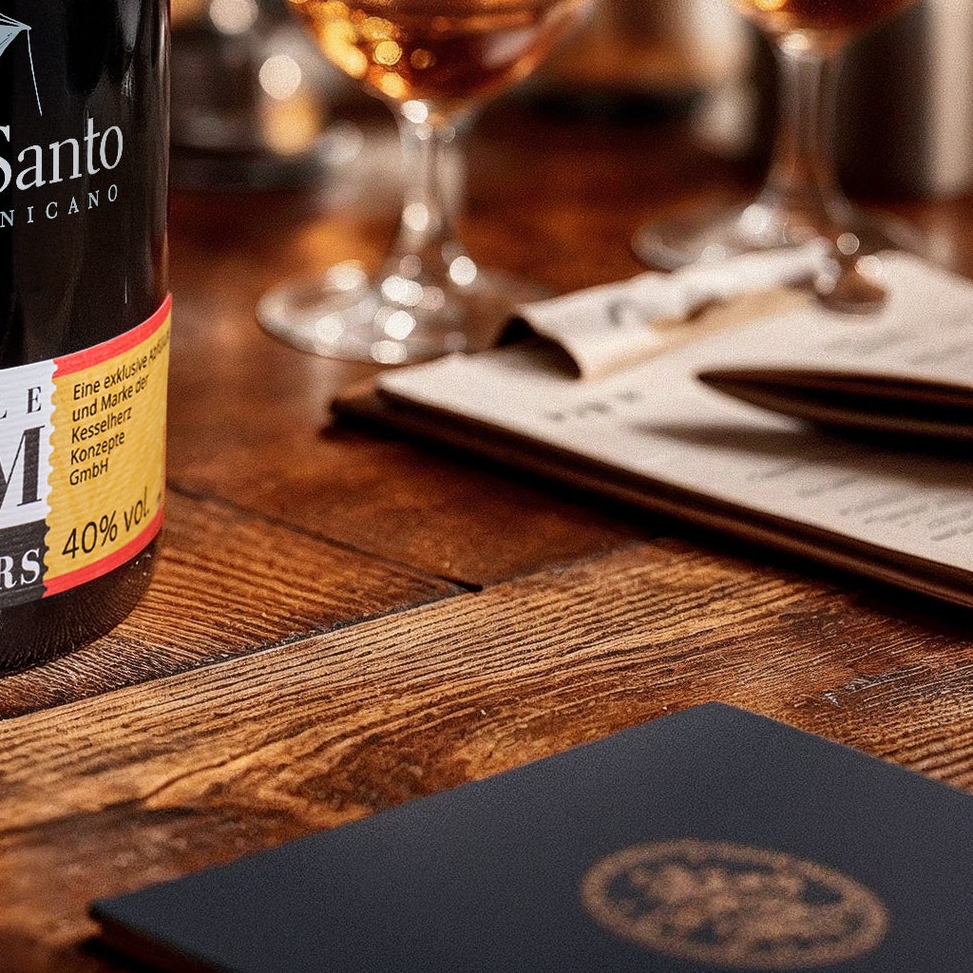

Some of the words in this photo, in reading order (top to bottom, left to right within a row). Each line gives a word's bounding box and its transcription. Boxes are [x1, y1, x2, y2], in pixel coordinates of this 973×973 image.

[73, 381, 101, 401] Eine
[103, 355, 147, 389] exklusive
[72, 398, 98, 423] und
[100, 385, 134, 412] Marke
[71, 406, 132, 444] Kesselherz
[70, 431, 125, 466] Konzepte
[69, 457, 109, 486] GmbH
[61, 509, 118, 560] 40%
[123, 485, 150, 532] vol.
